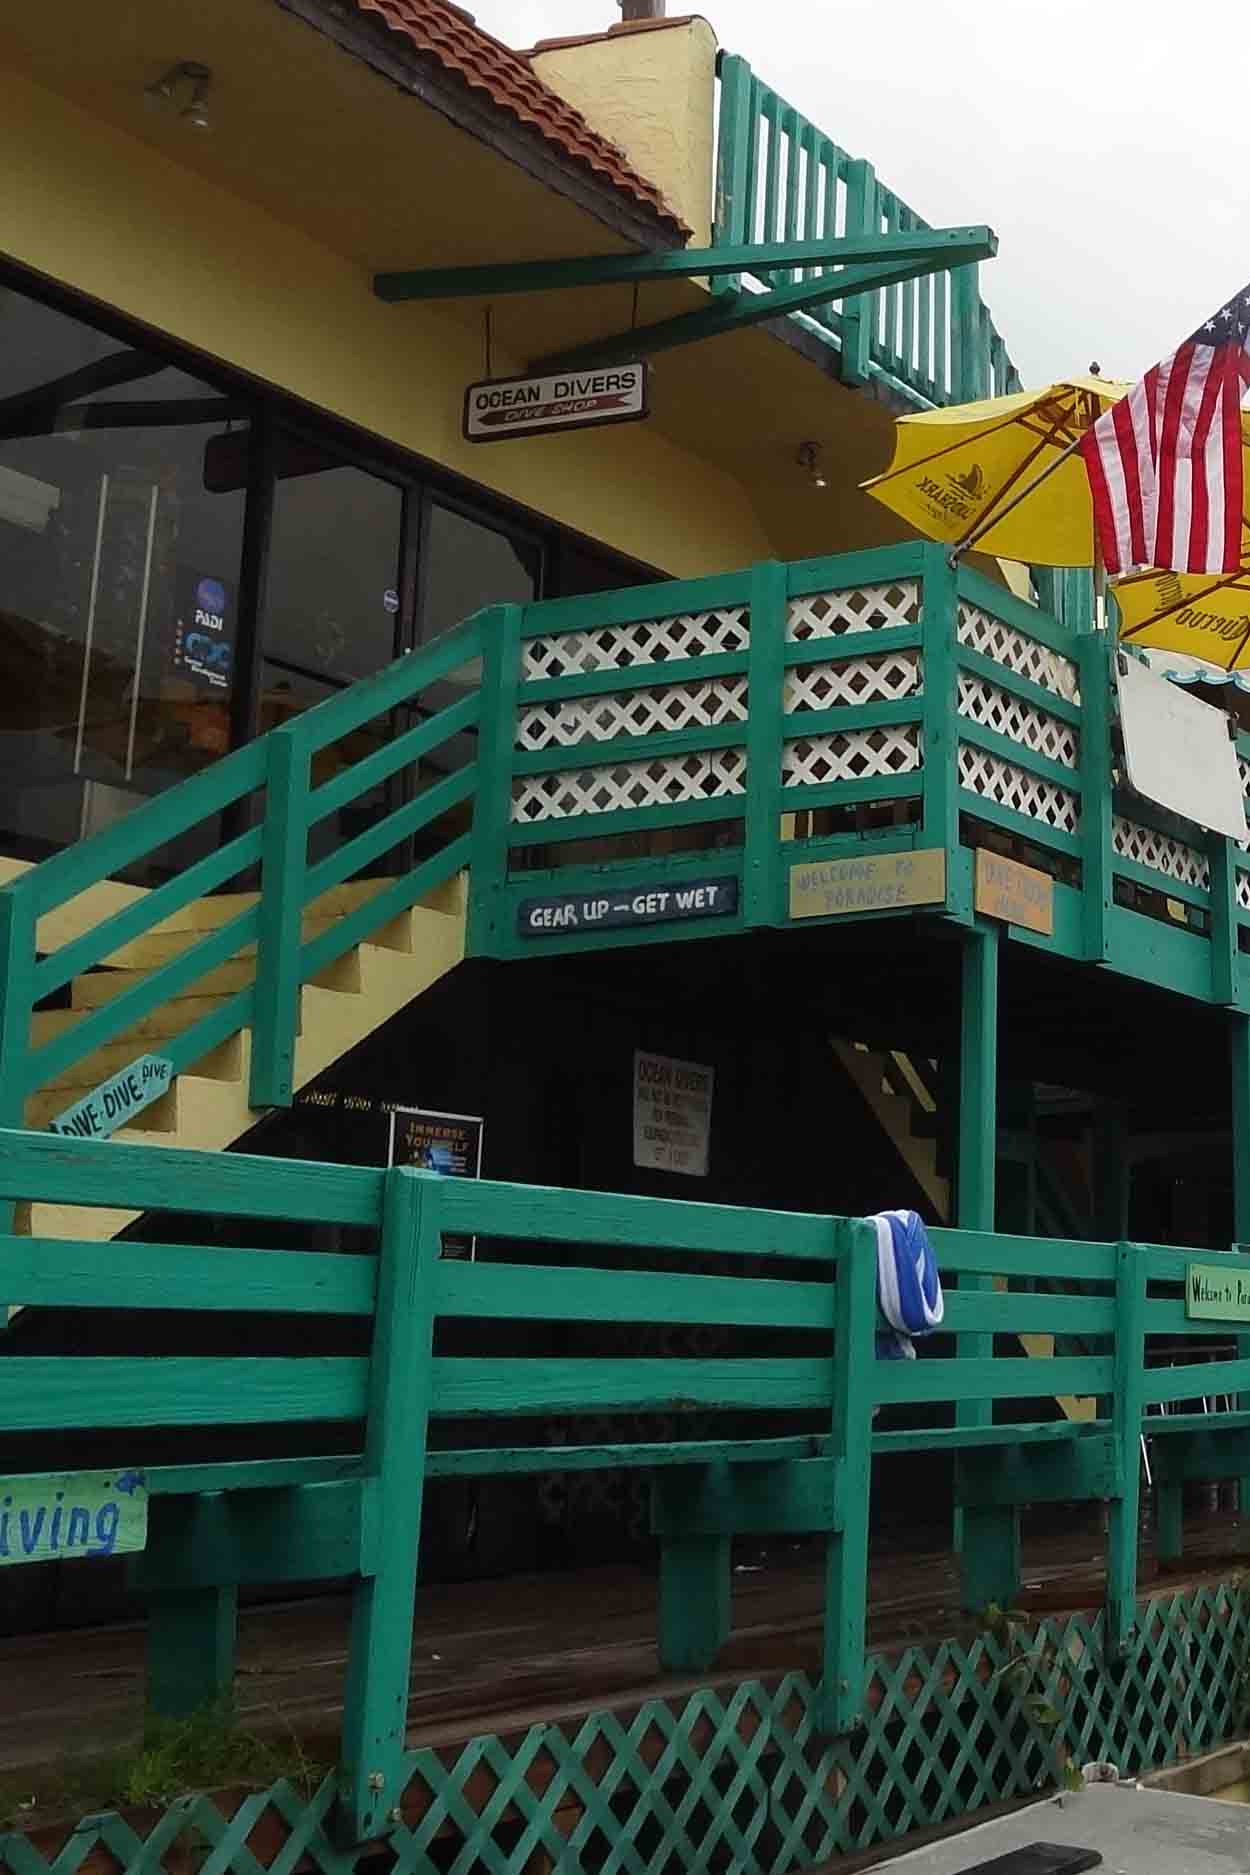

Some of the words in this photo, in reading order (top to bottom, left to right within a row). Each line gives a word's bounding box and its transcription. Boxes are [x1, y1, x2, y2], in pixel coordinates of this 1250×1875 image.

[476, 385, 540, 410] OCEAN
[554, 372, 636, 398] DIVERS
[504, 406, 545, 422] DIVE
[551, 399, 599, 415] SHOP
[799, 862, 879, 892] WELCOME
[529, 904, 578, 928] GEAR
[584, 900, 609, 920] UP
[632, 892, 670, 914] GET
[676, 886, 719, 909] WET
[142, 1064, 168, 1083] DIVE
[1192, 1274, 1222, 1303] Welcome
